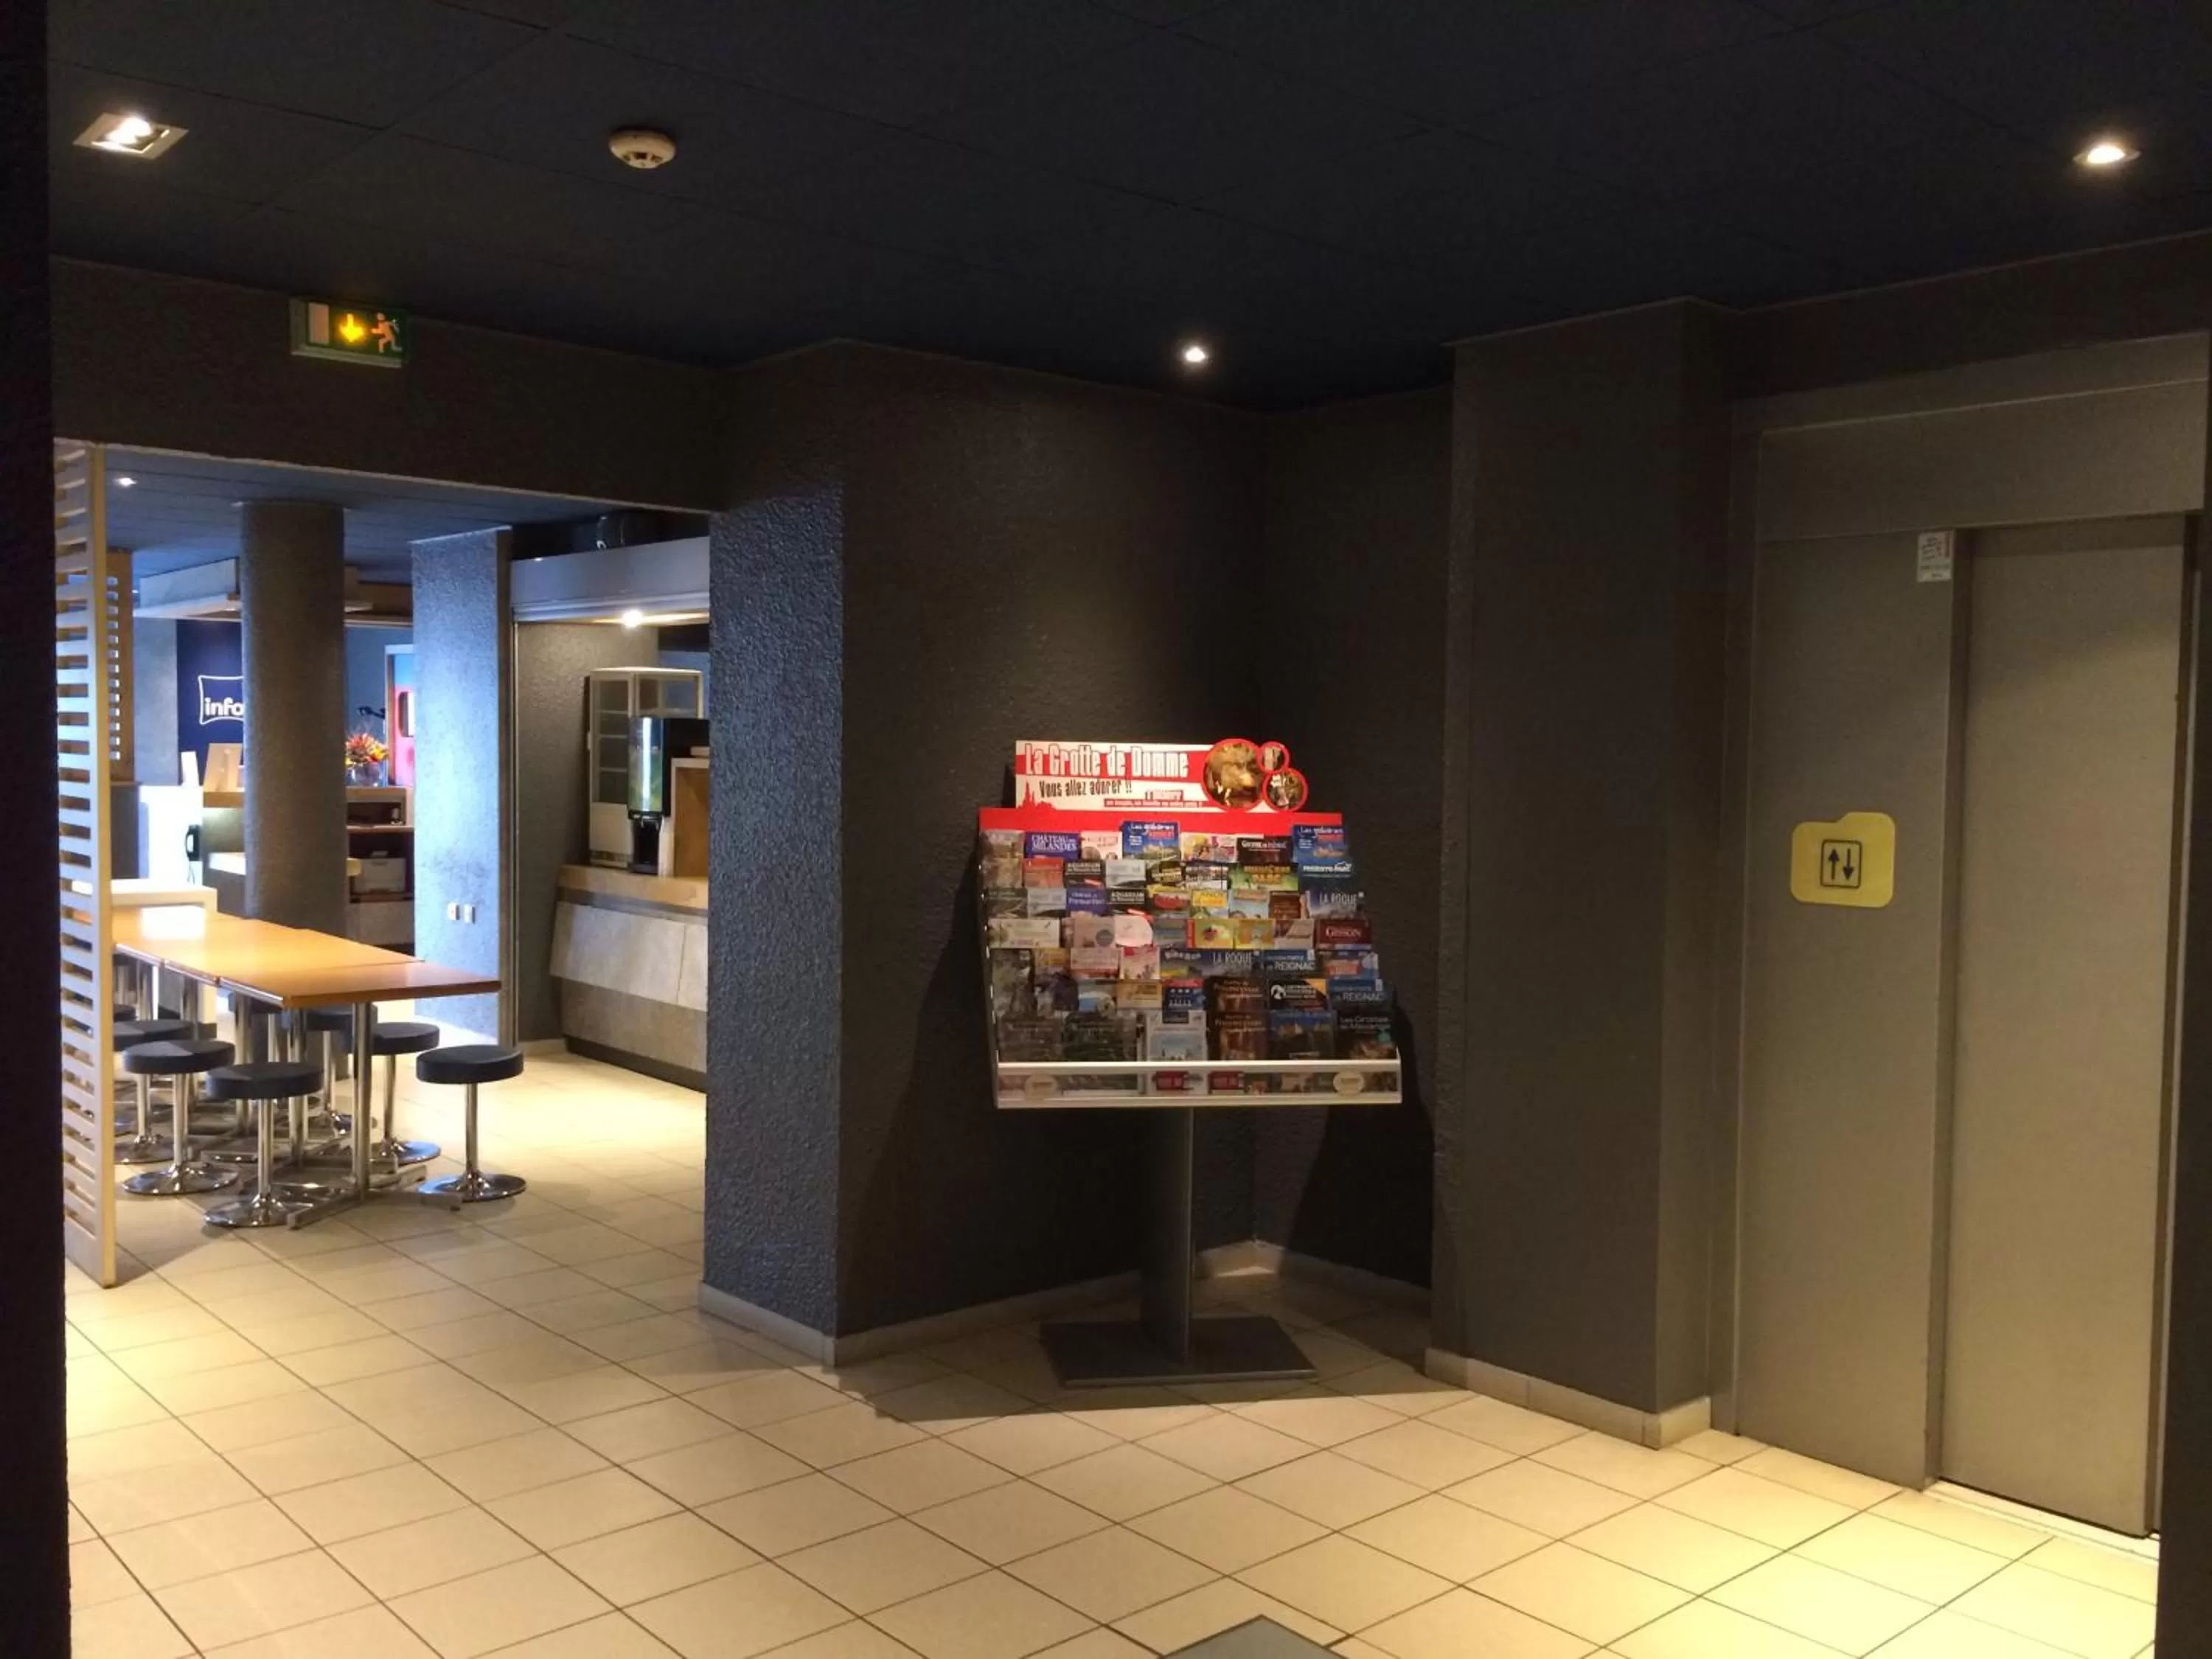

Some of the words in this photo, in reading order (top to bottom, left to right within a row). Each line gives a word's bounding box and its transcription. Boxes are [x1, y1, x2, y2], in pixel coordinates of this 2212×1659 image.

[1025, 743, 1044, 776] La
[1048, 743, 1101, 777] Grotte
[1107, 745, 1126, 778] de
[1131, 746, 1189, 779] Domme
[1039, 779, 1062, 799] Vous
[1065, 778, 1086, 796] allez
[1089, 778, 1123, 796] adorer
